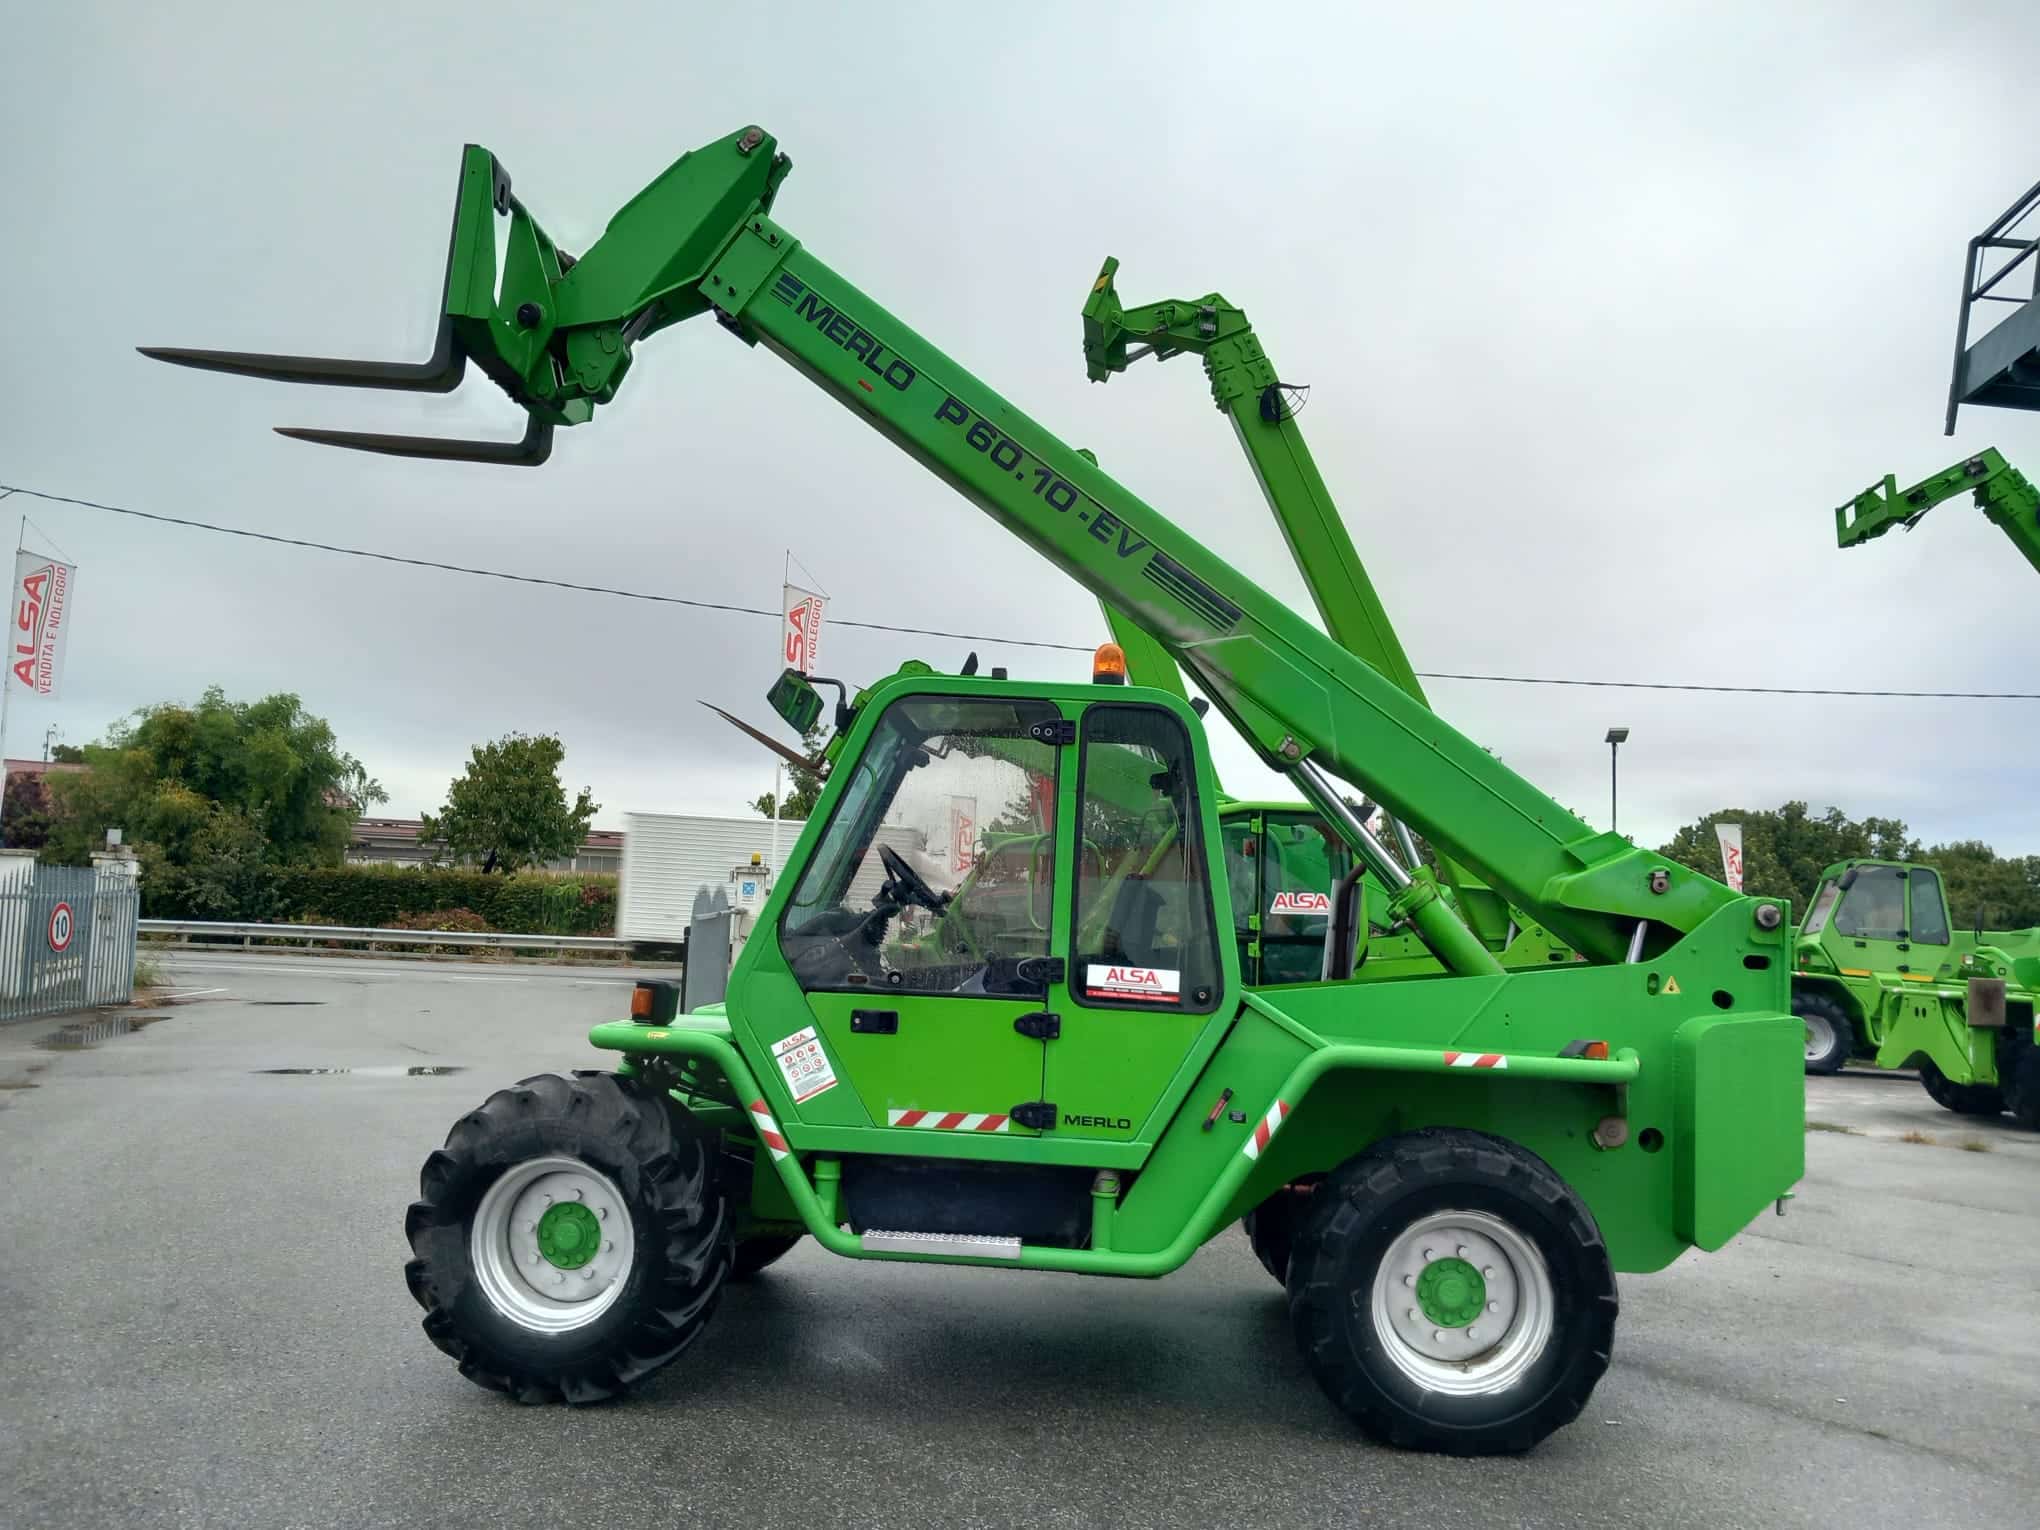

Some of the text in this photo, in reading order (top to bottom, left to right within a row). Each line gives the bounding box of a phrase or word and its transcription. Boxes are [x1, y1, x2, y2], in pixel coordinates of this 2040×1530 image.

[796, 293, 917, 392] MERLO
[14, 573, 48, 688] ALSA
[40, 566, 67, 694] VENDITA E NOLEGGIO
[808, 599, 823, 660] NOLEGGIO
[1274, 894, 1329, 909] ALSA
[55, 915, 69, 940] 10
[1106, 967, 1157, 985] ALSA
[782, 1033, 807, 1051] ALSA
[1064, 1114, 1131, 1130] MERLO
